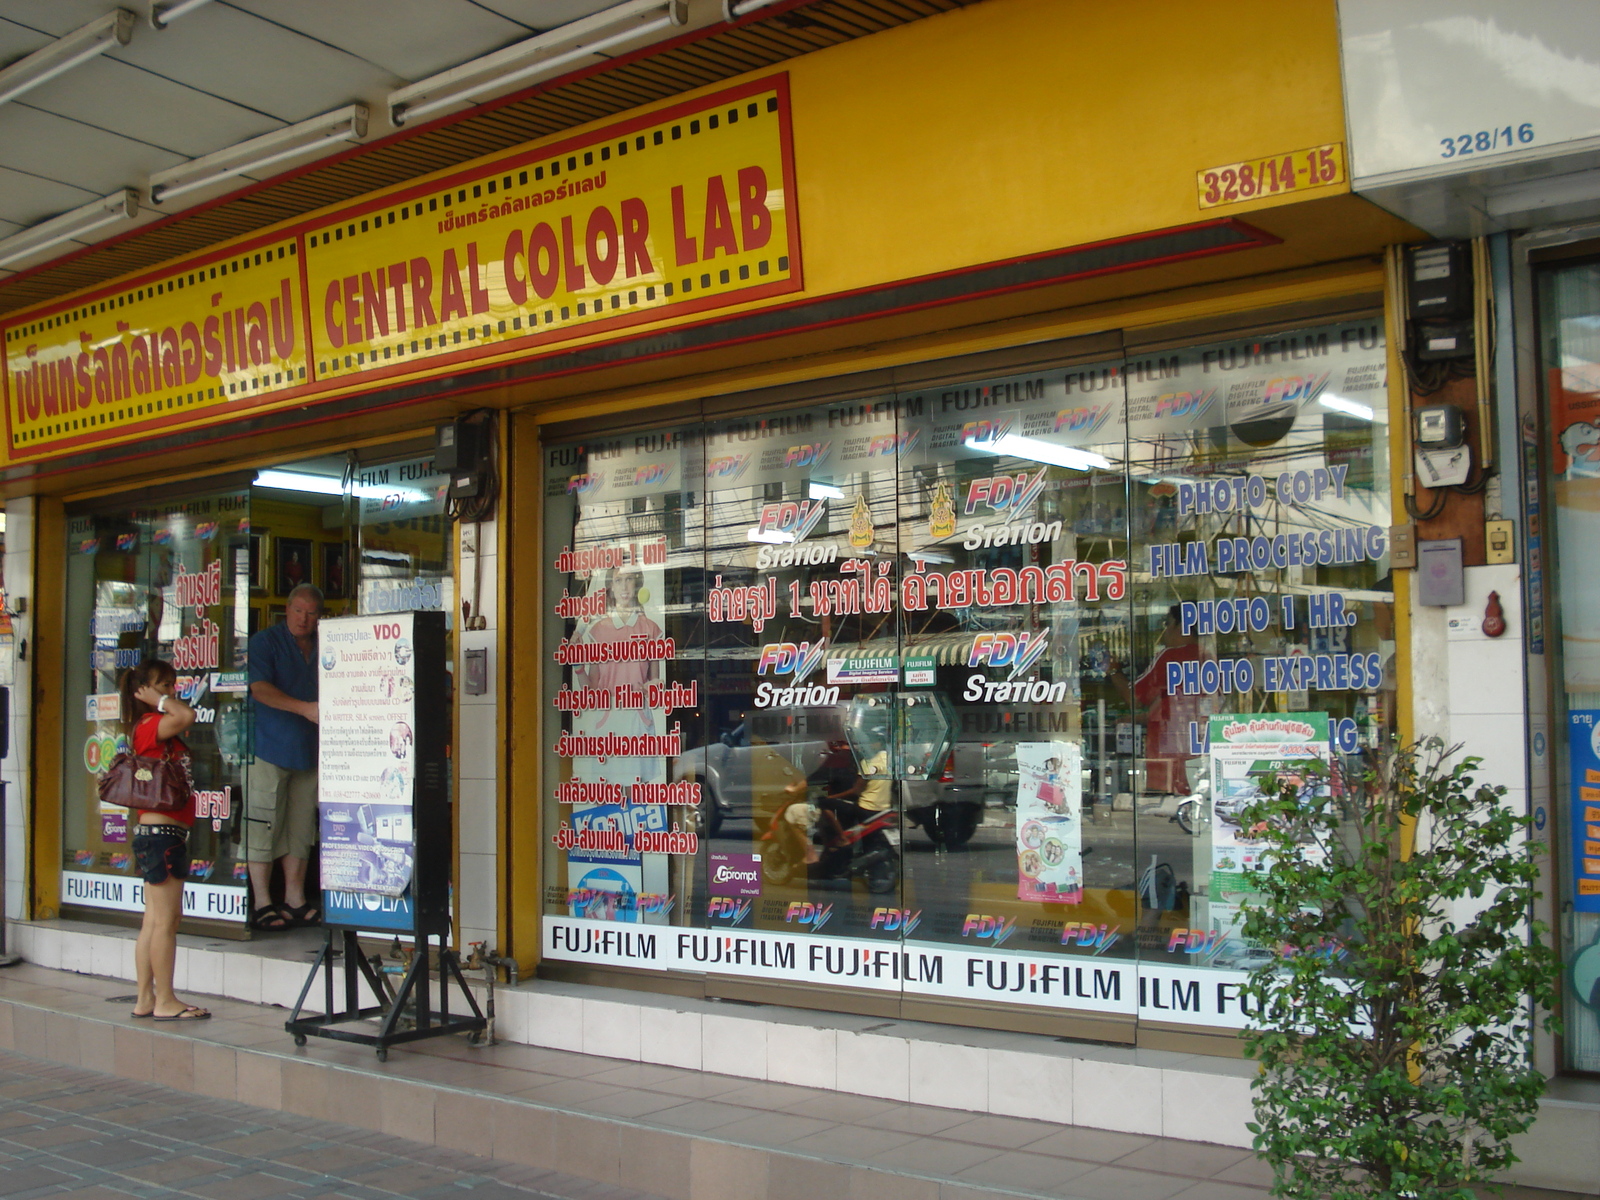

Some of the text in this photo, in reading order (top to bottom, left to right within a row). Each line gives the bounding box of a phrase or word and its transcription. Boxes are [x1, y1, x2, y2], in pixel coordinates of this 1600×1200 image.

[1440, 123, 1534, 158] 328/16
[1203, 147, 1336, 203] 328/14-15
[437, 172, 607, 234] เซ็นทรัลคัลเลอร์แลป
[324, 165, 773, 348] CENTRAL COLOR LAB
[15, 278, 294, 424] เซ็นทรัลคัลเลอร์แลป
[550, 333, 1328, 467] FUJIFILM FUJIFILM FUJIFILM FUJIFILM FUJIFILM FUJIFILM FUJIFILM
[1228, 390, 1258, 400] DIGITAL
[1230, 379, 1266, 391] FUJIFILM
[1025, 411, 1056, 421] FUJIFILM
[1226, 398, 1262, 409] IMAGING
[1021, 428, 1052, 437] IMAGING
[1023, 420, 1049, 429] DIGITAL
[360, 468, 389, 488] FILM
[1179, 463, 1349, 516] PHOTO COPY
[629, 543, 637, 566] 1
[643, 535, 667, 565] นาที
[963, 518, 1062, 551] Station
[756, 542, 839, 570] Station
[1149, 525, 1386, 579] FILM PROCESSING
[175, 558, 221, 619] ล้างรูปสี
[709, 558, 1127, 633] ถ่ายรูป 1 นาทีได้ ถ่ายเอกสาร
[1181, 592, 1358, 636] PHOTO 1 HR.
[173, 618, 219, 670] รอรับได้
[373, 623, 401, 640] VDO
[849, 658, 892, 670] FUJIFILM
[907, 660, 932, 668] FUJIFILM
[1166, 652, 1383, 696] PHOTO EXPRESS
[614, 683, 644, 708] Film
[648, 680, 698, 715] Digital
[754, 682, 840, 708] Station
[963, 674, 1067, 703] Station
[962, 711, 1068, 734] FUJIFILM
[631, 777, 701, 805] ถ่ายเอกสาร
[574, 804, 664, 837] Konica
[633, 823, 698, 855] ซ่อมกล้อง
[67, 877, 123, 902] FUJIFILM
[552, 925, 656, 959] FUJIFILM
[677, 934, 795, 969] FUJIFILM
[809, 944, 943, 984] FUJIFILM
[967, 958, 1121, 1001] FUJIFILM
[1139, 976, 1200, 1012] ILM
